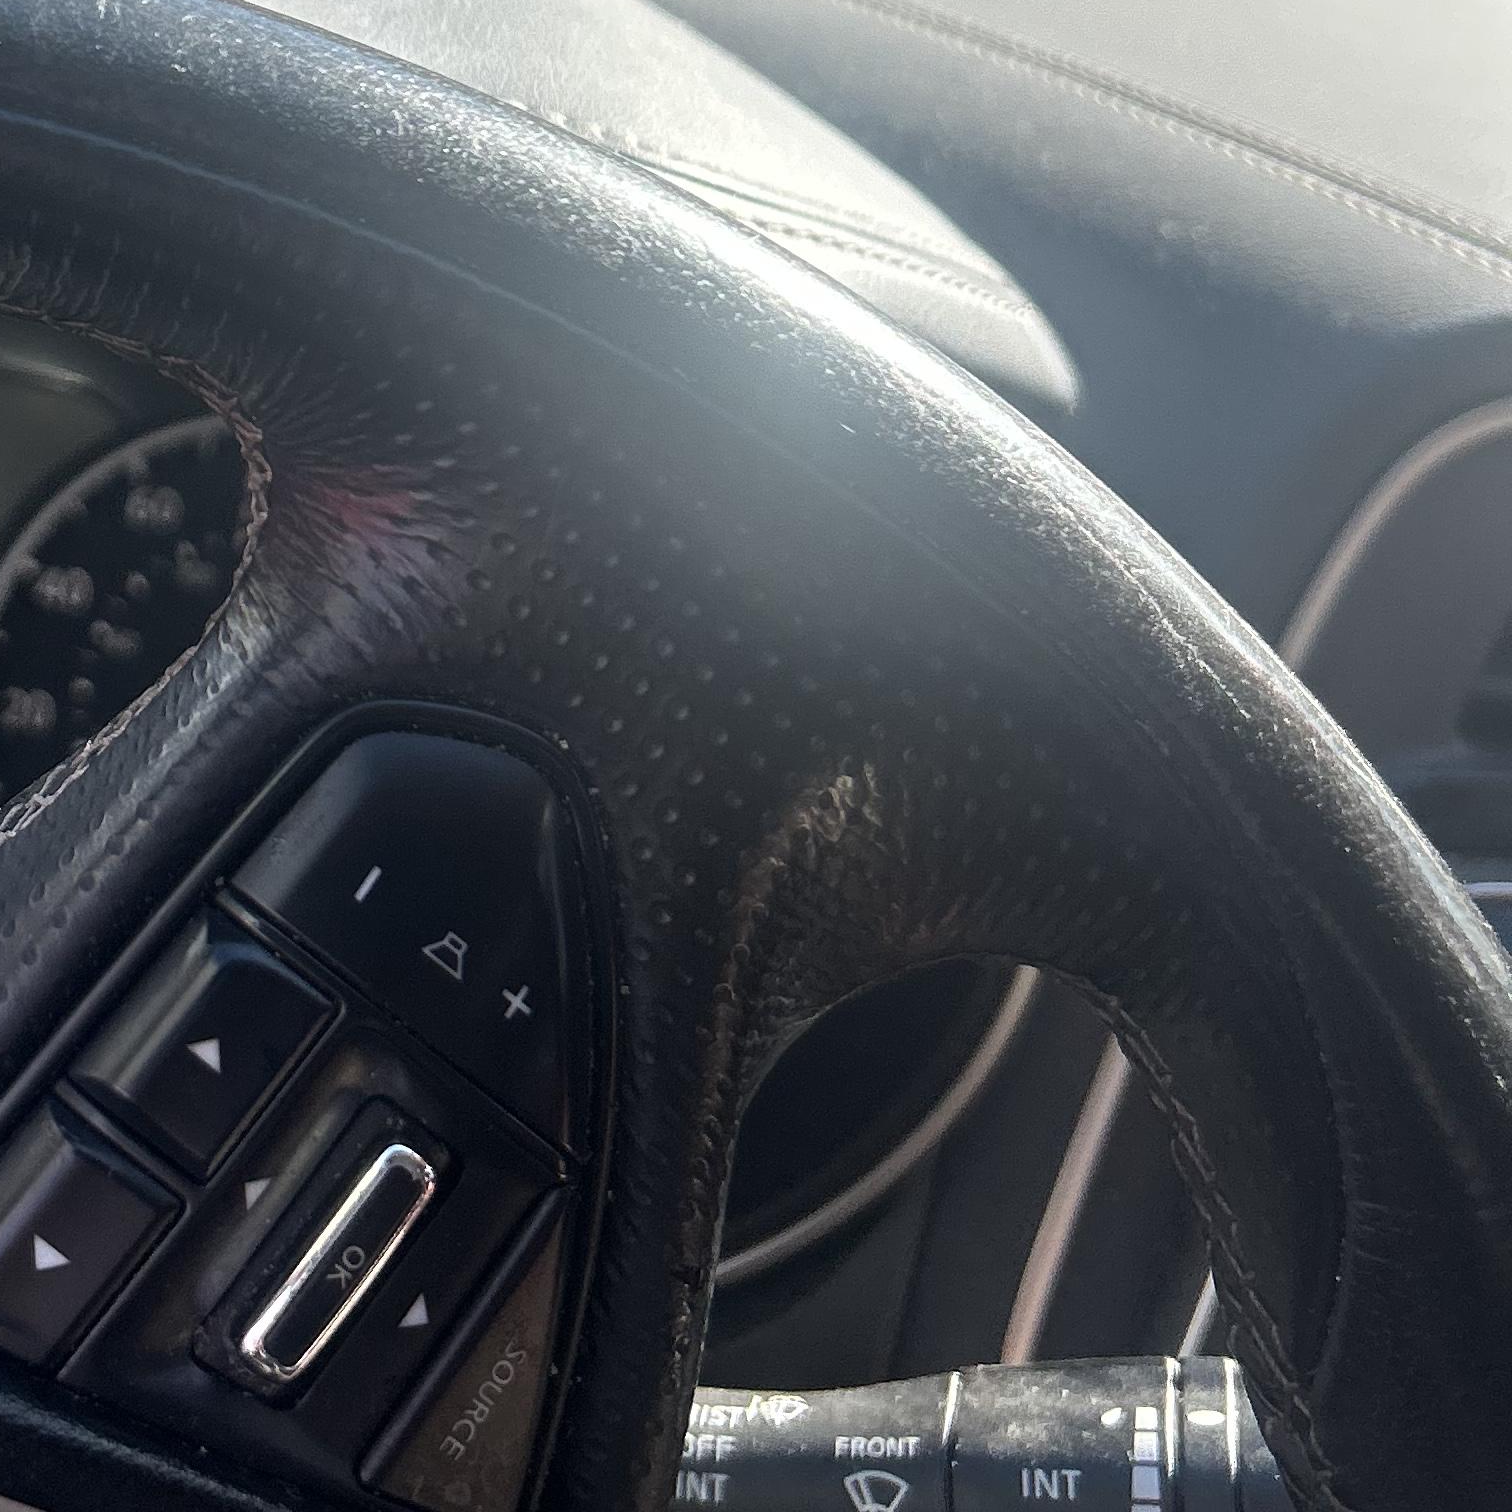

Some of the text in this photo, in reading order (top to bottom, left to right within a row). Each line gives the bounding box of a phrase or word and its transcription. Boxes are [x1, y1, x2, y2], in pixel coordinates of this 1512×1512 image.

[327, 1245, 366, 1289] OK
[439, 1338, 528, 1462] SOURCE
[835, 1436, 920, 1459] FRONT
[675, 1470, 729, 1505] INT
[1021, 1468, 1081, 1502] INT
